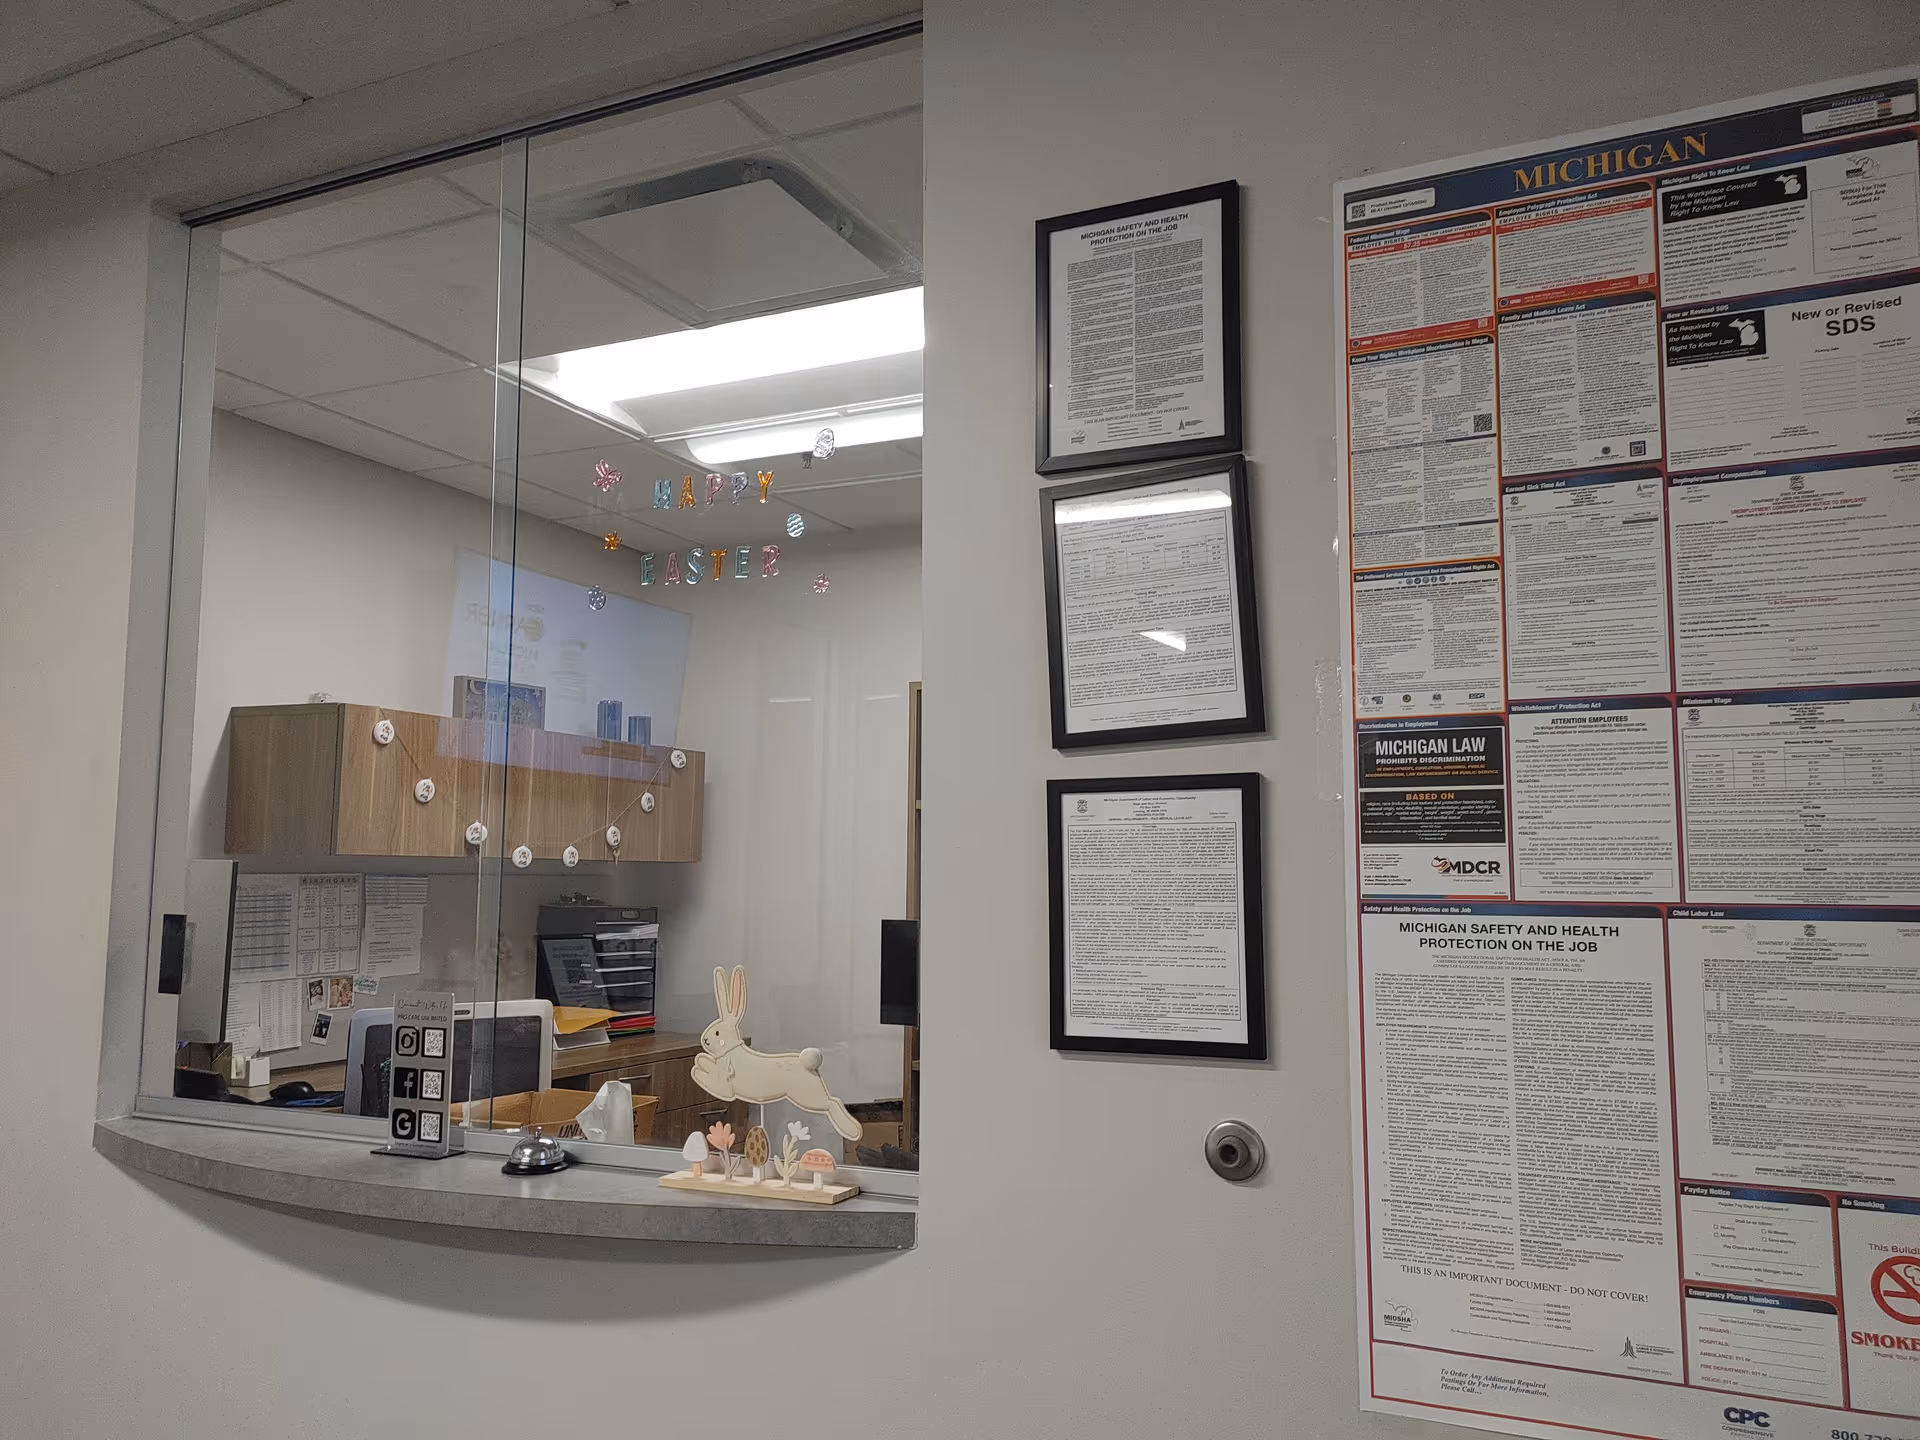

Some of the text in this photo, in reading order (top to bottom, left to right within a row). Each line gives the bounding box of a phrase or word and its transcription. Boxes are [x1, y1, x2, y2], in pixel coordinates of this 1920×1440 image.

[1514, 132, 1707, 192] MICHIGAN
[1662, 175, 1689, 186] Michigan
[1691, 172, 1708, 181] Right
[1718, 167, 1735, 175] Know
[1688, 187, 1724, 198] Workplace
[1726, 181, 1758, 191] Covered
[1499, 206, 1526, 216] Employee
[1527, 201, 1556, 212] Polygraph
[1557, 196, 1586, 206] Protection
[1670, 202, 1678, 210] by
[1694, 194, 1727, 206] Michigan
[1500, 209, 1558, 224] EMPLOYEE RIGHTS
[1670, 209, 1689, 218] Right
[1702, 203, 1722, 211] Know
[1081, 213, 1188, 240] MICHIGAN SAFETY AND HEALTH
[1090, 232, 1134, 246] PROTECTION
[1163, 224, 1177, 232] JOB
[1352, 242, 1381, 250] EMPLOYEE
[1501, 313, 1520, 322] Family
[1534, 309, 1556, 318] Medical
[1558, 306, 1574, 314] Leave
[1792, 296, 1902, 321] New or Revised
[1680, 322, 1710, 332] Required
[1826, 315, 1875, 336] SDS
[1682, 332, 1712, 341] Michigan
[652, 470, 774, 510] HAPPY
[640, 544, 780, 586] EASTER
[1551, 717, 1587, 725] ATTENTION
[1376, 737, 1486, 756] MICHIGAN LAW
[1420, 756, 1486, 764] DISCRIMINATION
[1449, 861, 1500, 874] MDCR
[1400, 923, 1619, 936] MICHIGAN SAFETY AND HEALTH
[1420, 938, 1598, 952] PROTECTION ON THE JOB
[1684, 1186, 1708, 1195] Payday
[1842, 1198, 1885, 1209] No Smoking
[1868, 1243, 1888, 1251] This
[1400, 1265, 1421, 1274] THIS
[1450, 1271, 1503, 1285] IMPORTANT
[1506, 1278, 1562, 1292] DOCUMENT
[1570, 1287, 1584, 1295] DO
[1587, 1289, 1608, 1298] NOT
[1610, 1292, 1648, 1302] COVER!
[1688, 1289, 1780, 1305] Emergency Phone Numbers
[1384, 1314, 1411, 1322] MIOSHA
[1440, 1376, 1466, 1385] Postings
[1491, 1383, 1507, 1391] More
[1441, 1383, 1460, 1391] Please
[1483, 1375, 1516, 1384] Additional
[1518, 1379, 1546, 1389] Required
[1724, 1407, 1770, 1427] CPC
[1722, 1425, 1774, 1437] COMPREHENSIVE
[1831, 1430, 1858, 1440] 800
